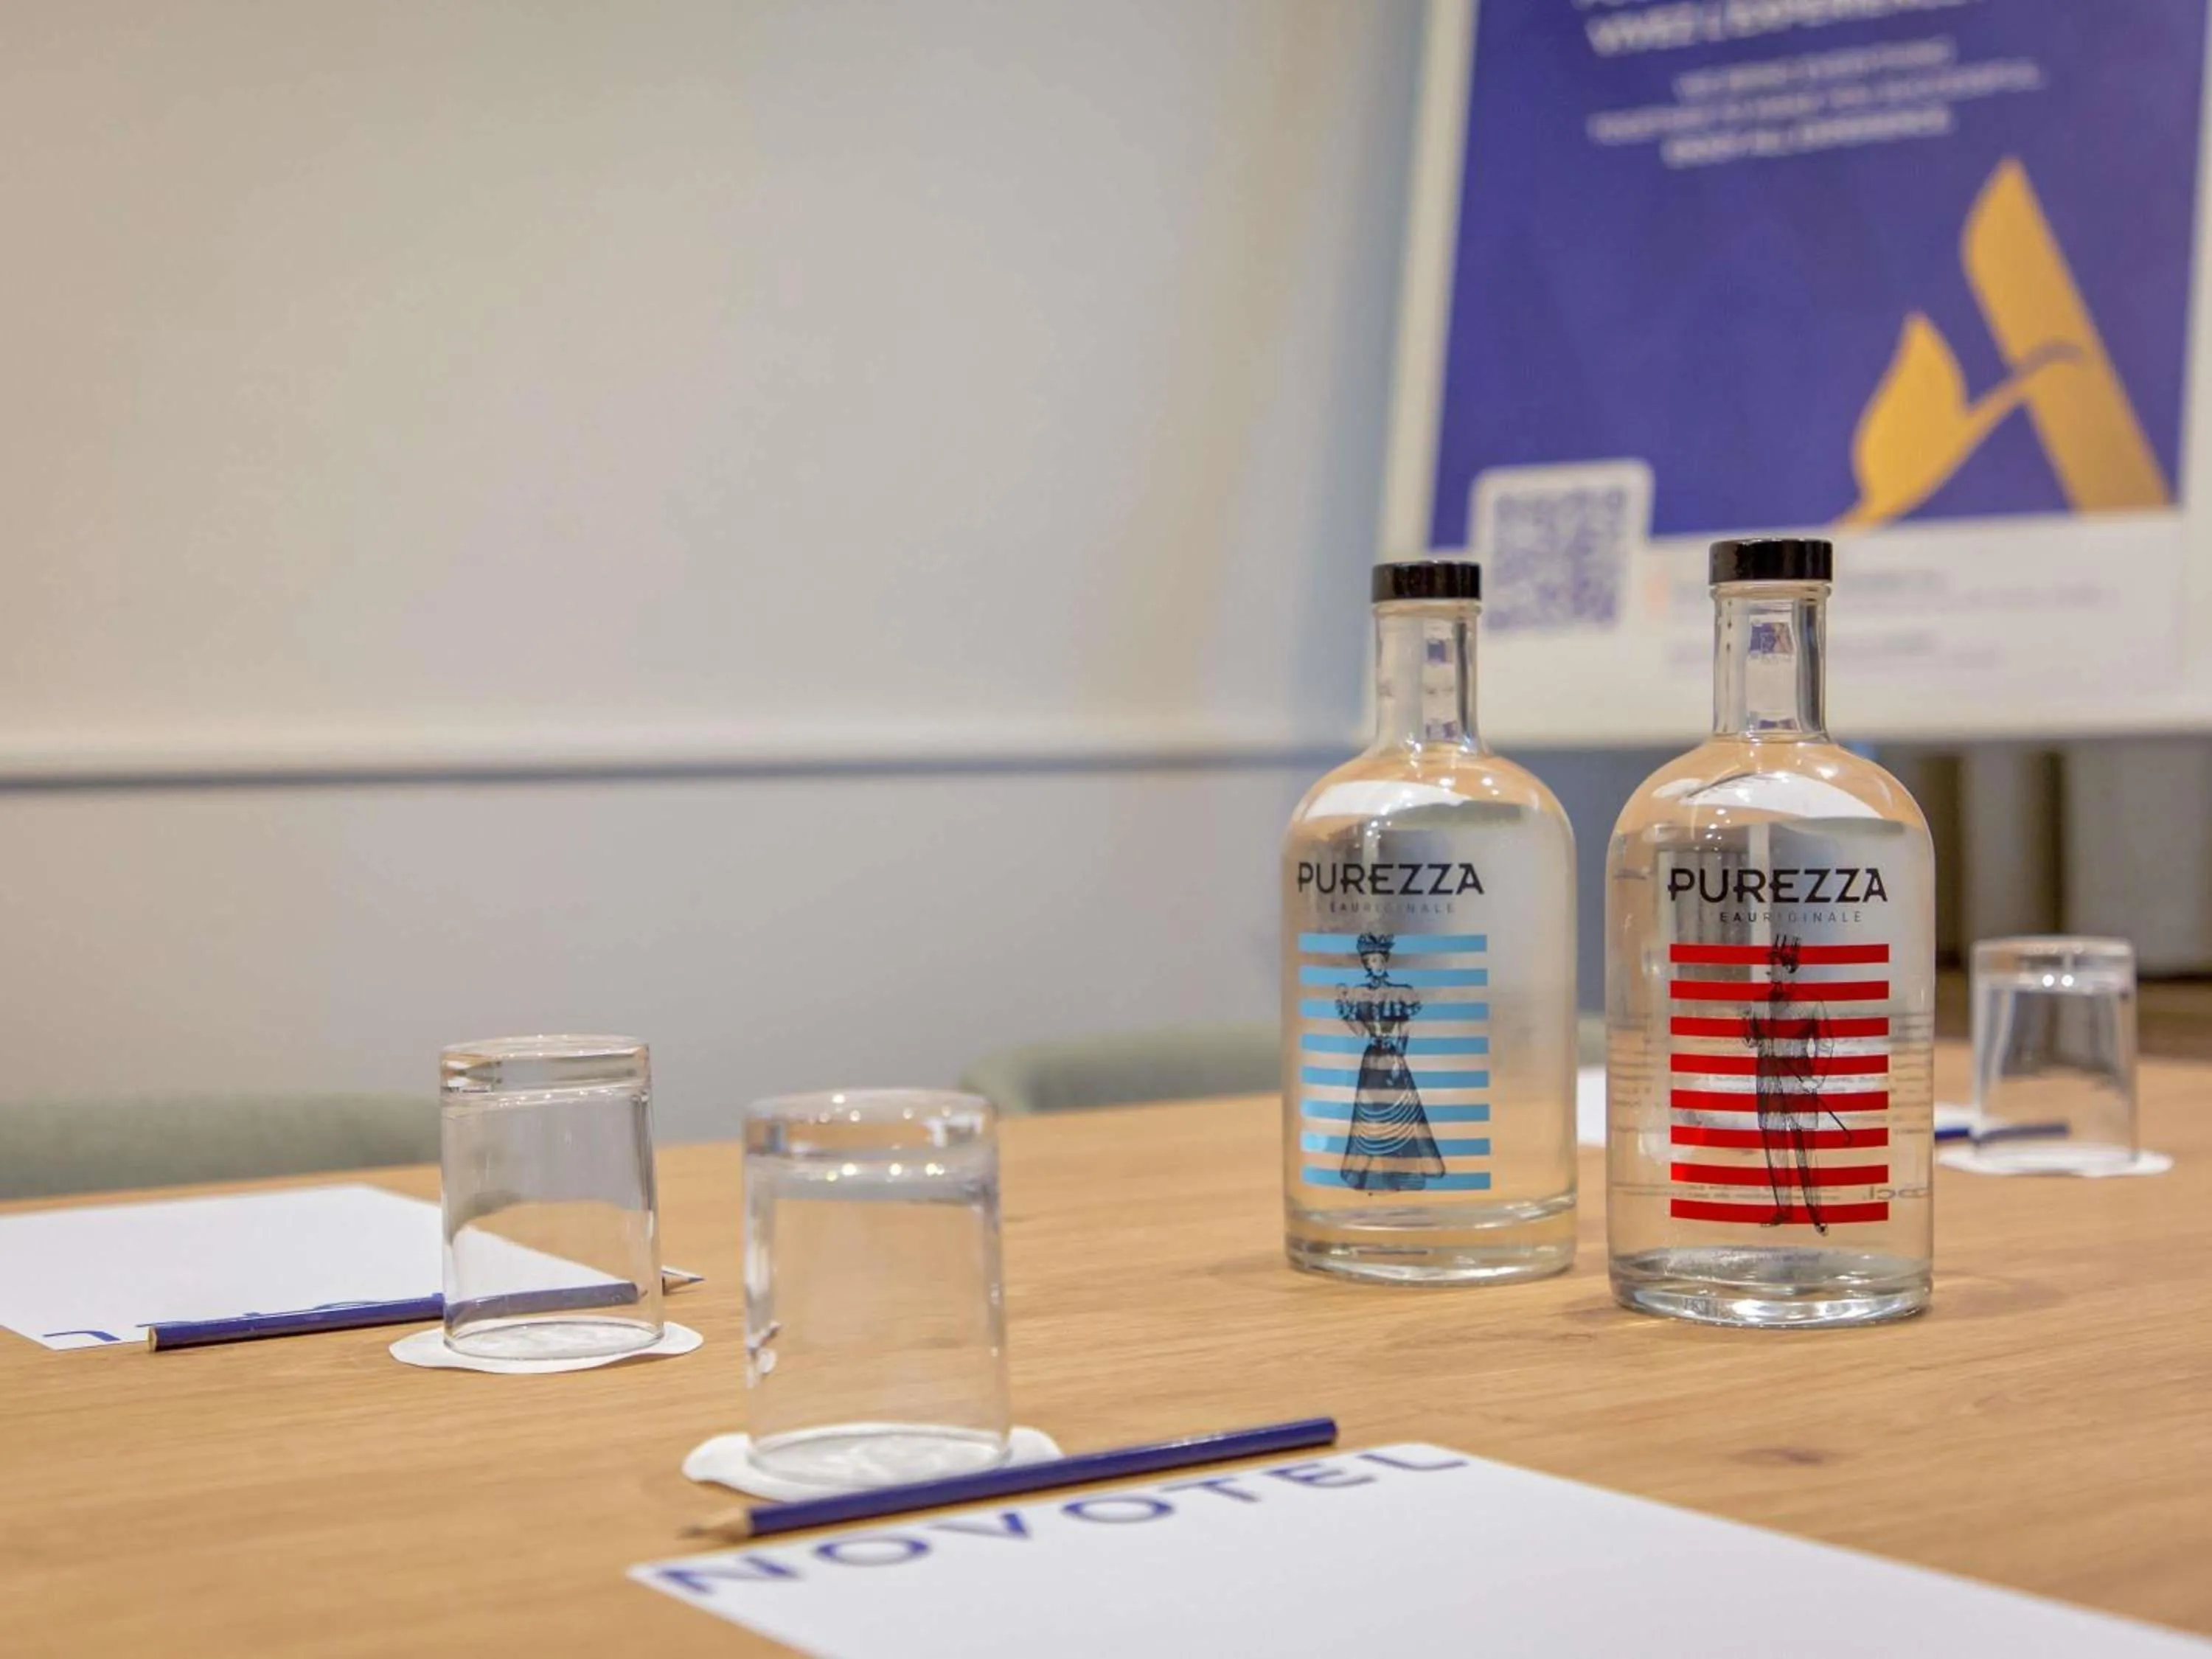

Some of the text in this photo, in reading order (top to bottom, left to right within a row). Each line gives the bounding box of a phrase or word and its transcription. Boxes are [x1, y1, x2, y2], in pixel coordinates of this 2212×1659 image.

[1298, 862, 1485, 895] PUREZZA
[1668, 869, 1888, 903] PUREZZA
[656, 1451, 1469, 1595] NOVOTEL
